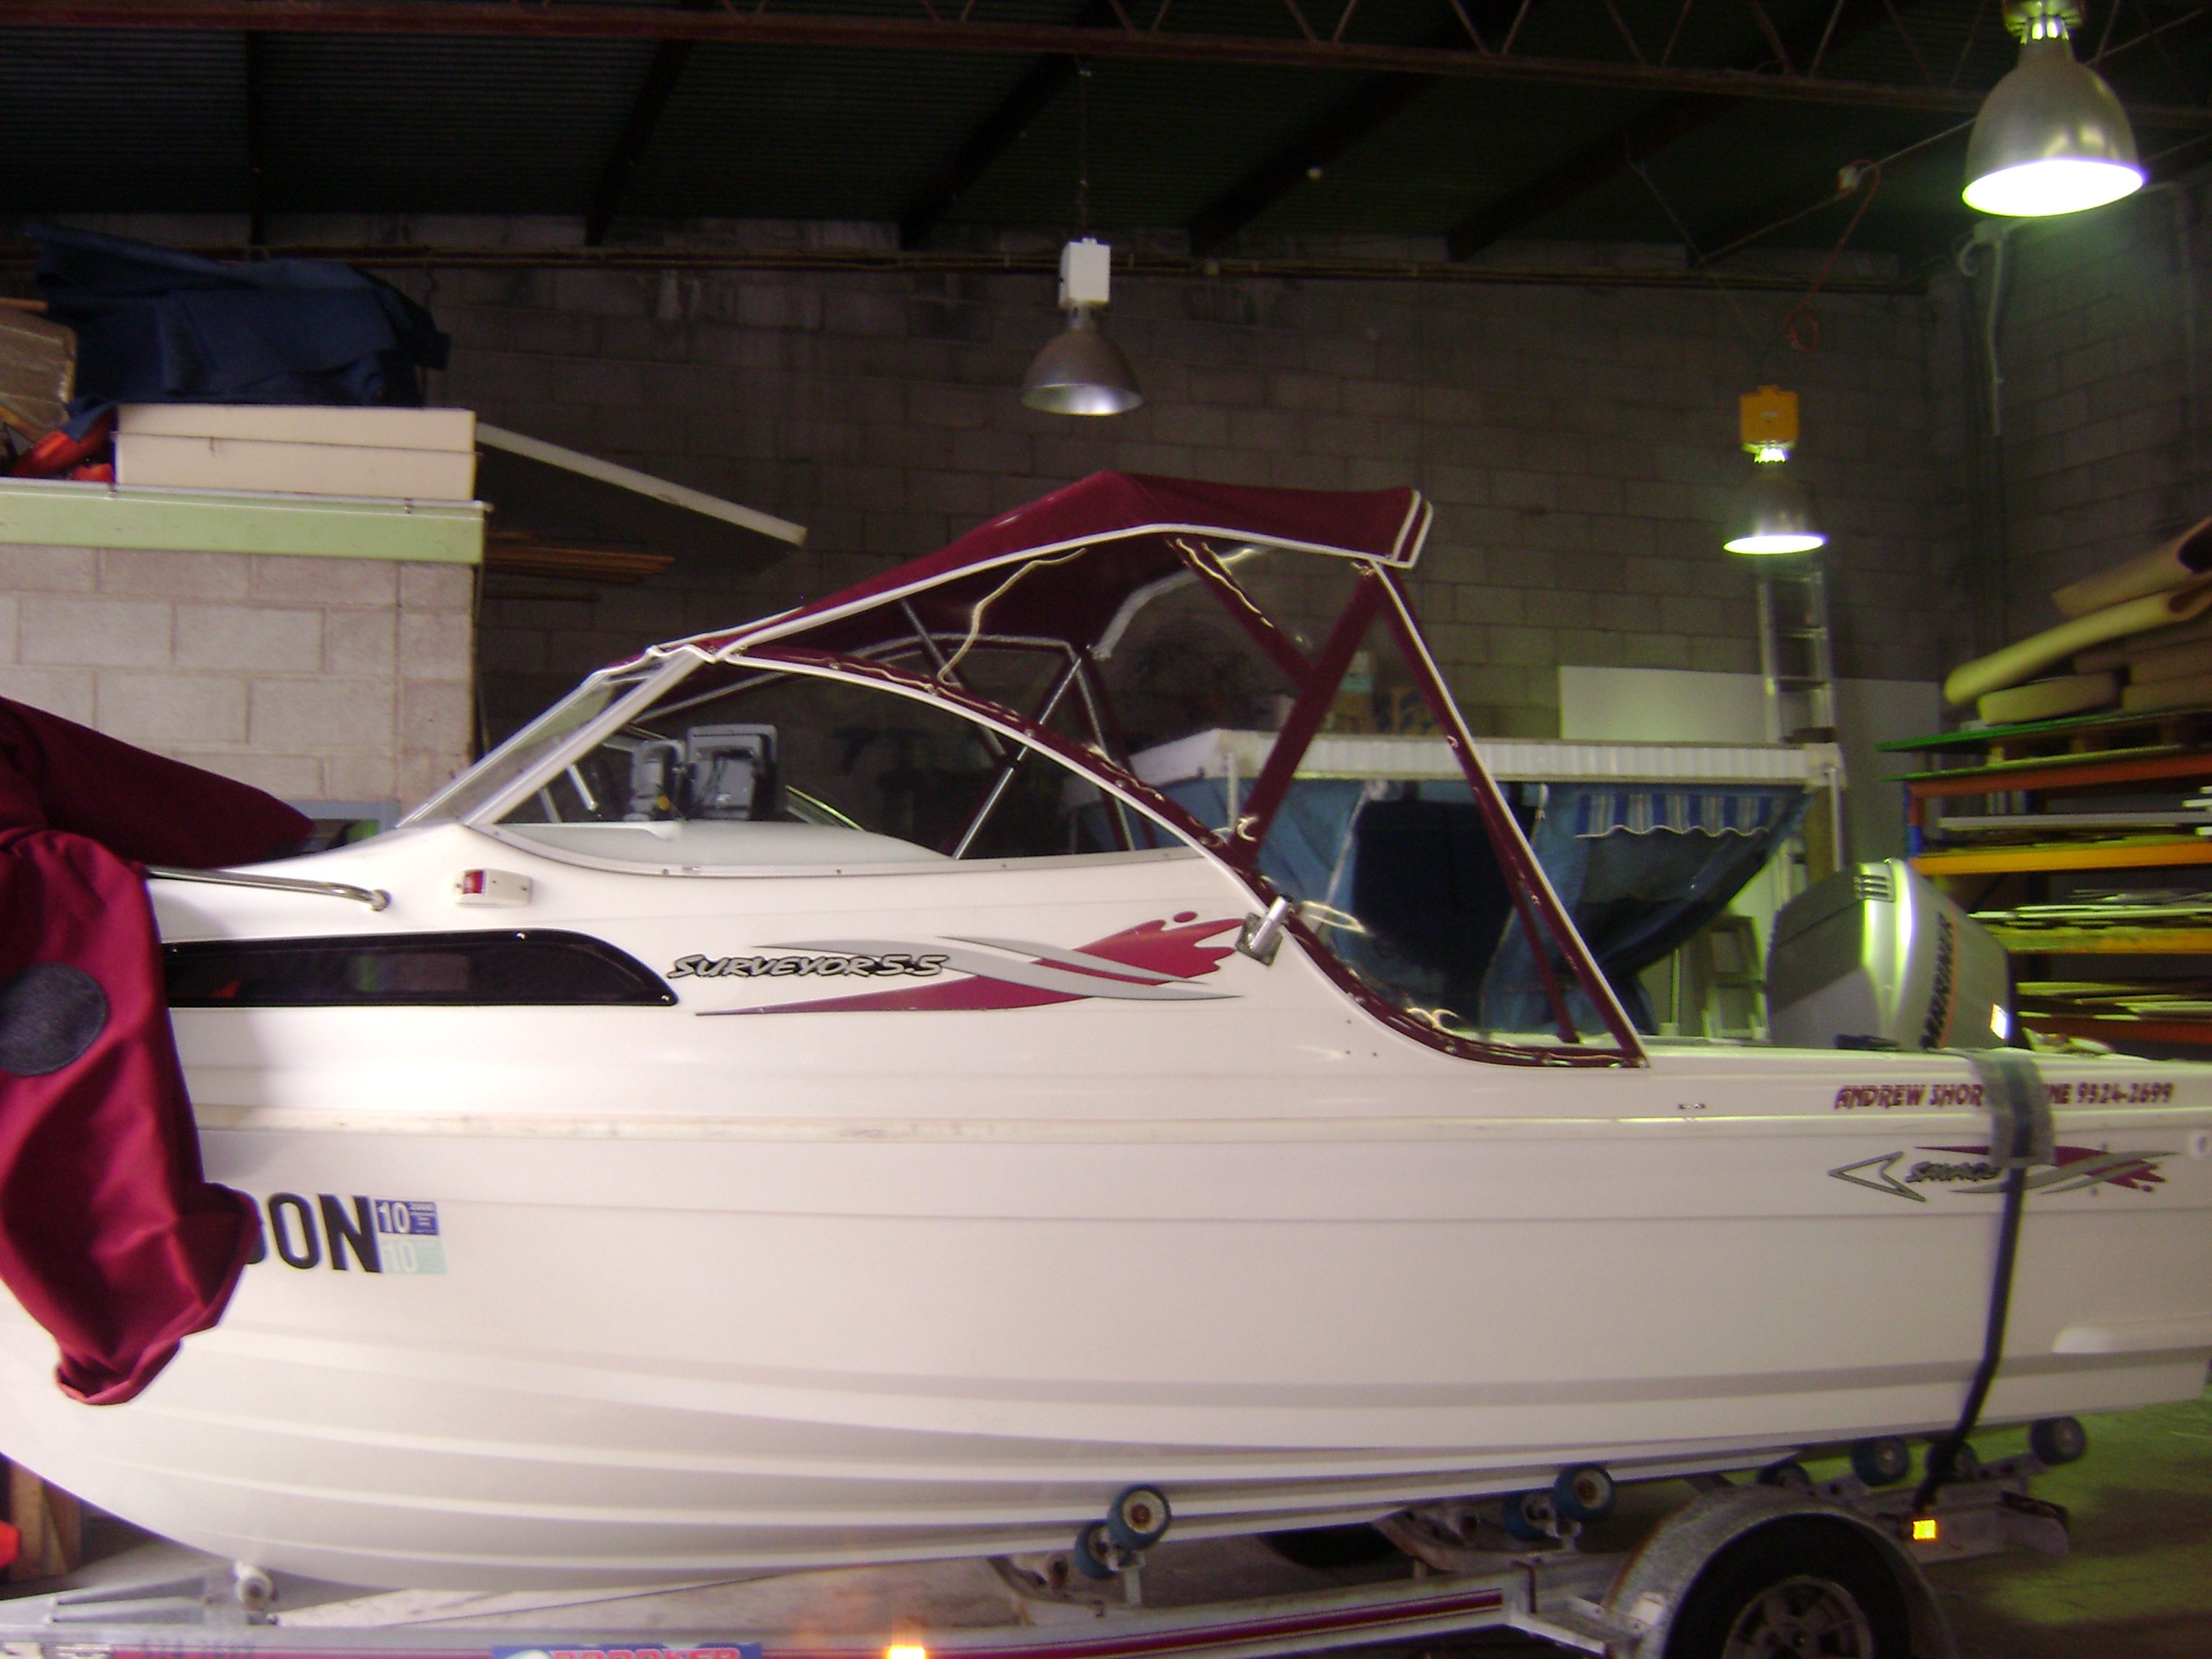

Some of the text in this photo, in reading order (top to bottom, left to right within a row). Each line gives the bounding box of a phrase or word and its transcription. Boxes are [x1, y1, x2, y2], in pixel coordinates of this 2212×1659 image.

[1834, 1084, 1925, 1109] ANDREW
[1929, 1084, 1986, 1107] SHOR
[247, 1192, 383, 1273] ON
[377, 1201, 410, 1233] 10
